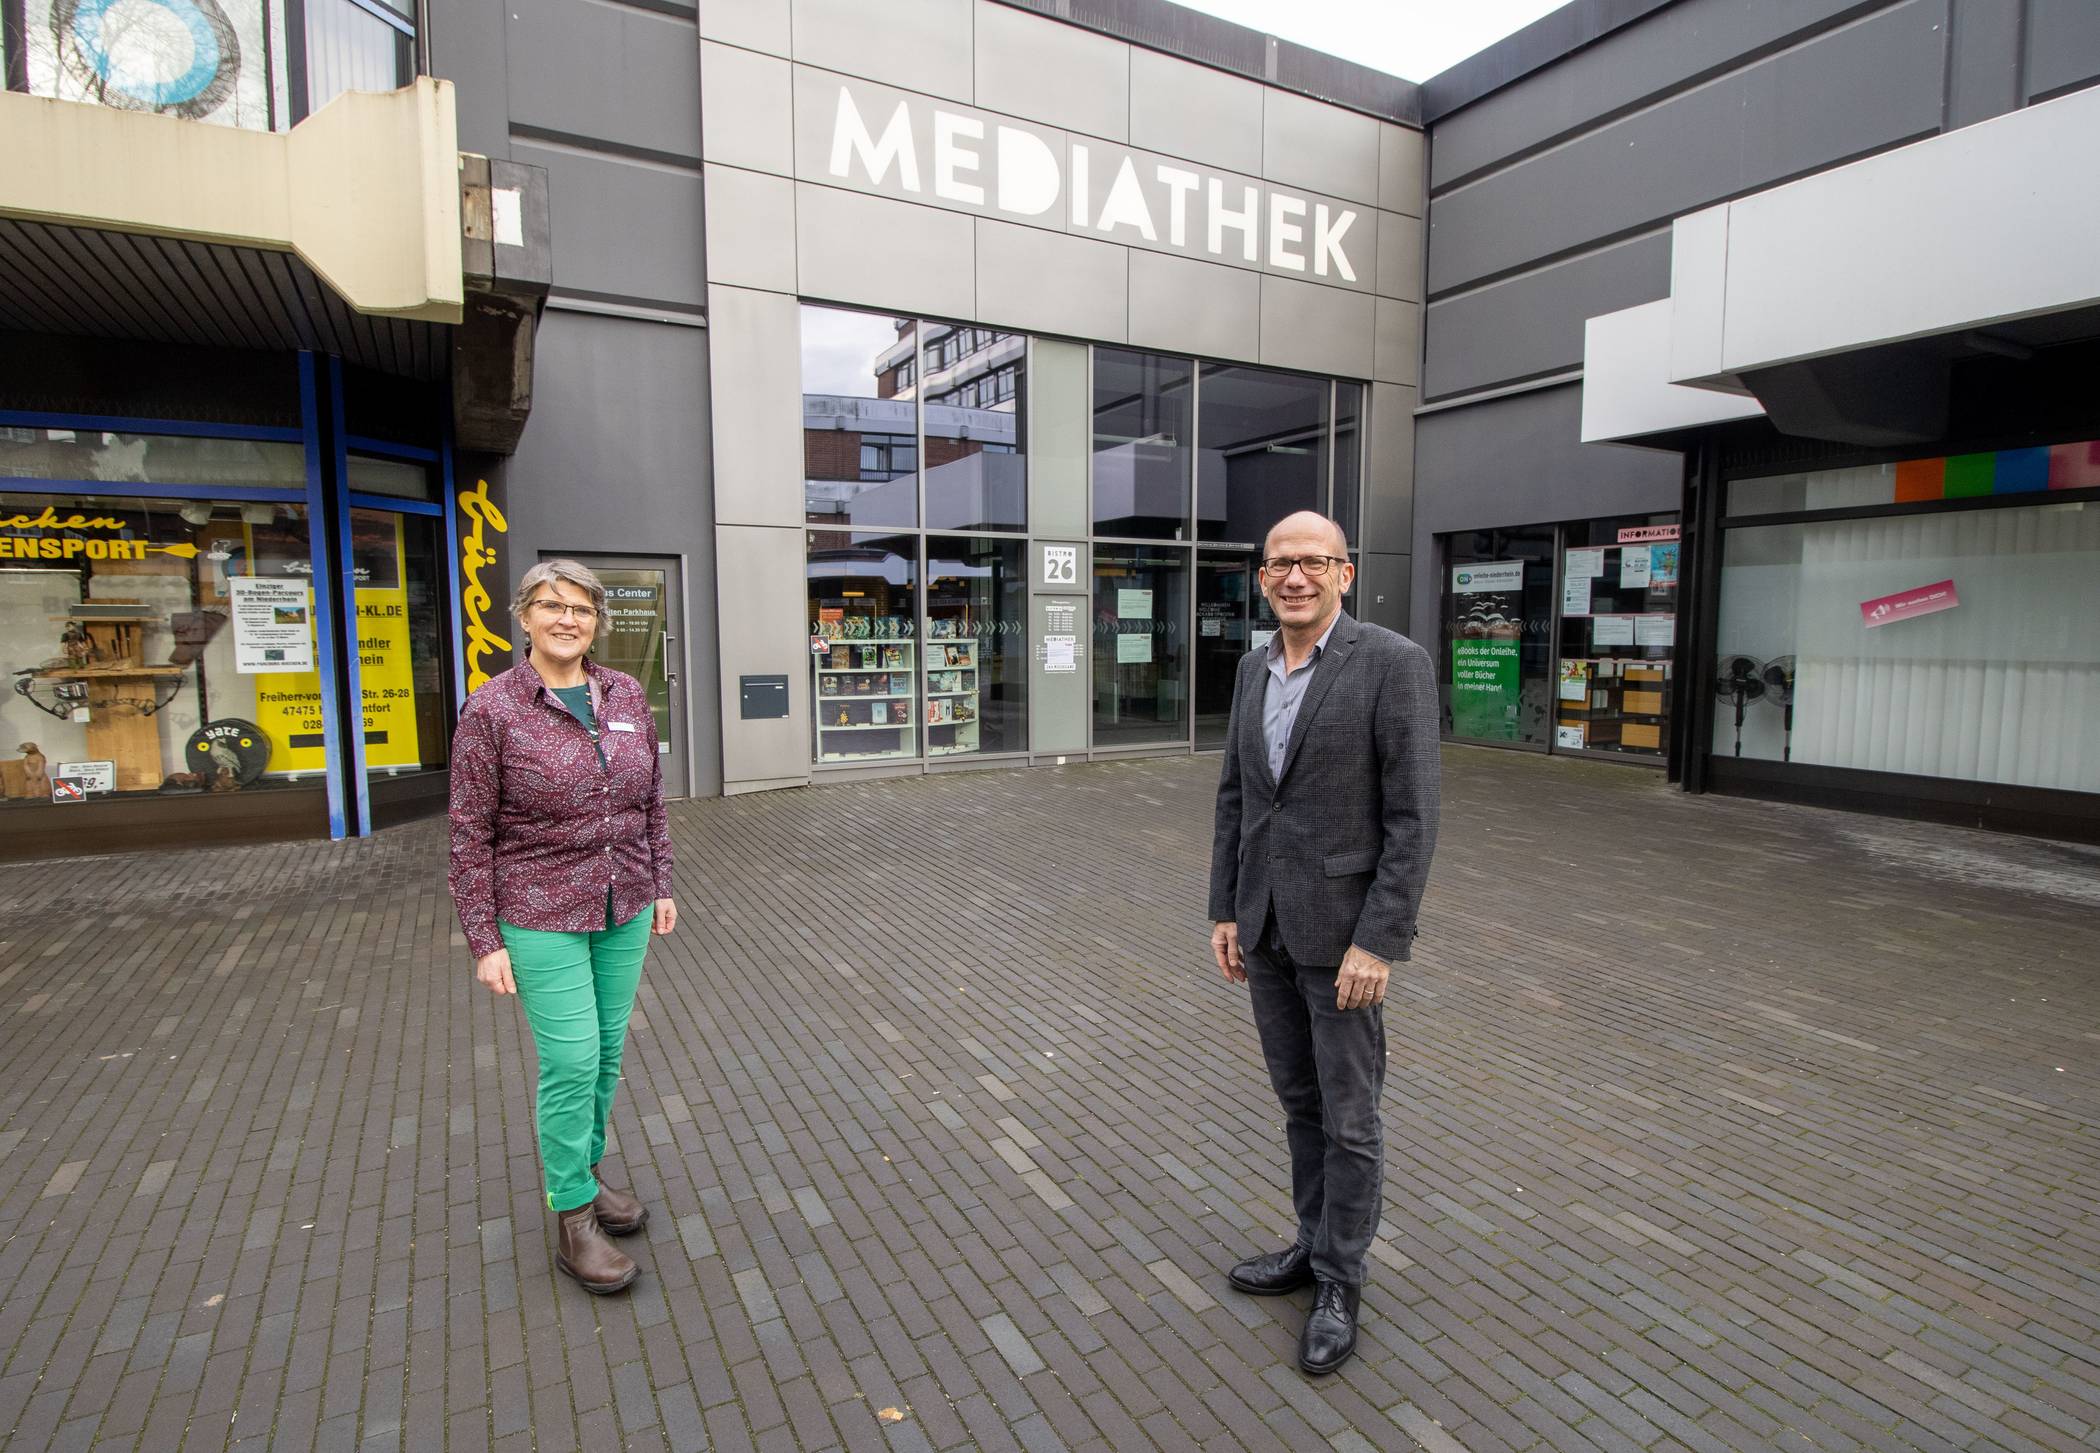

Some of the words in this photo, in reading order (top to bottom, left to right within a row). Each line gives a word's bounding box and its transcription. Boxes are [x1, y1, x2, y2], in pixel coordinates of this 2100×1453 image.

[829, 86, 1357, 282] MEDIATHEK
[1620, 527, 1680, 539] INFORMATIO
[1048, 559, 1073, 580] 26
[617, 588, 652, 598] Center
[1457, 646, 1479, 655] eBooks
[1480, 646, 1491, 655] der
[1491, 647, 1518, 656] Onleihe,
[1457, 659, 1467, 667] ein
[1467, 659, 1500, 668] Universum
[1457, 670, 1474, 679] voller
[1474, 671, 1496, 680] Bücher
[382, 688, 410, 699] 26-28
[282, 706, 316, 716] 47475
